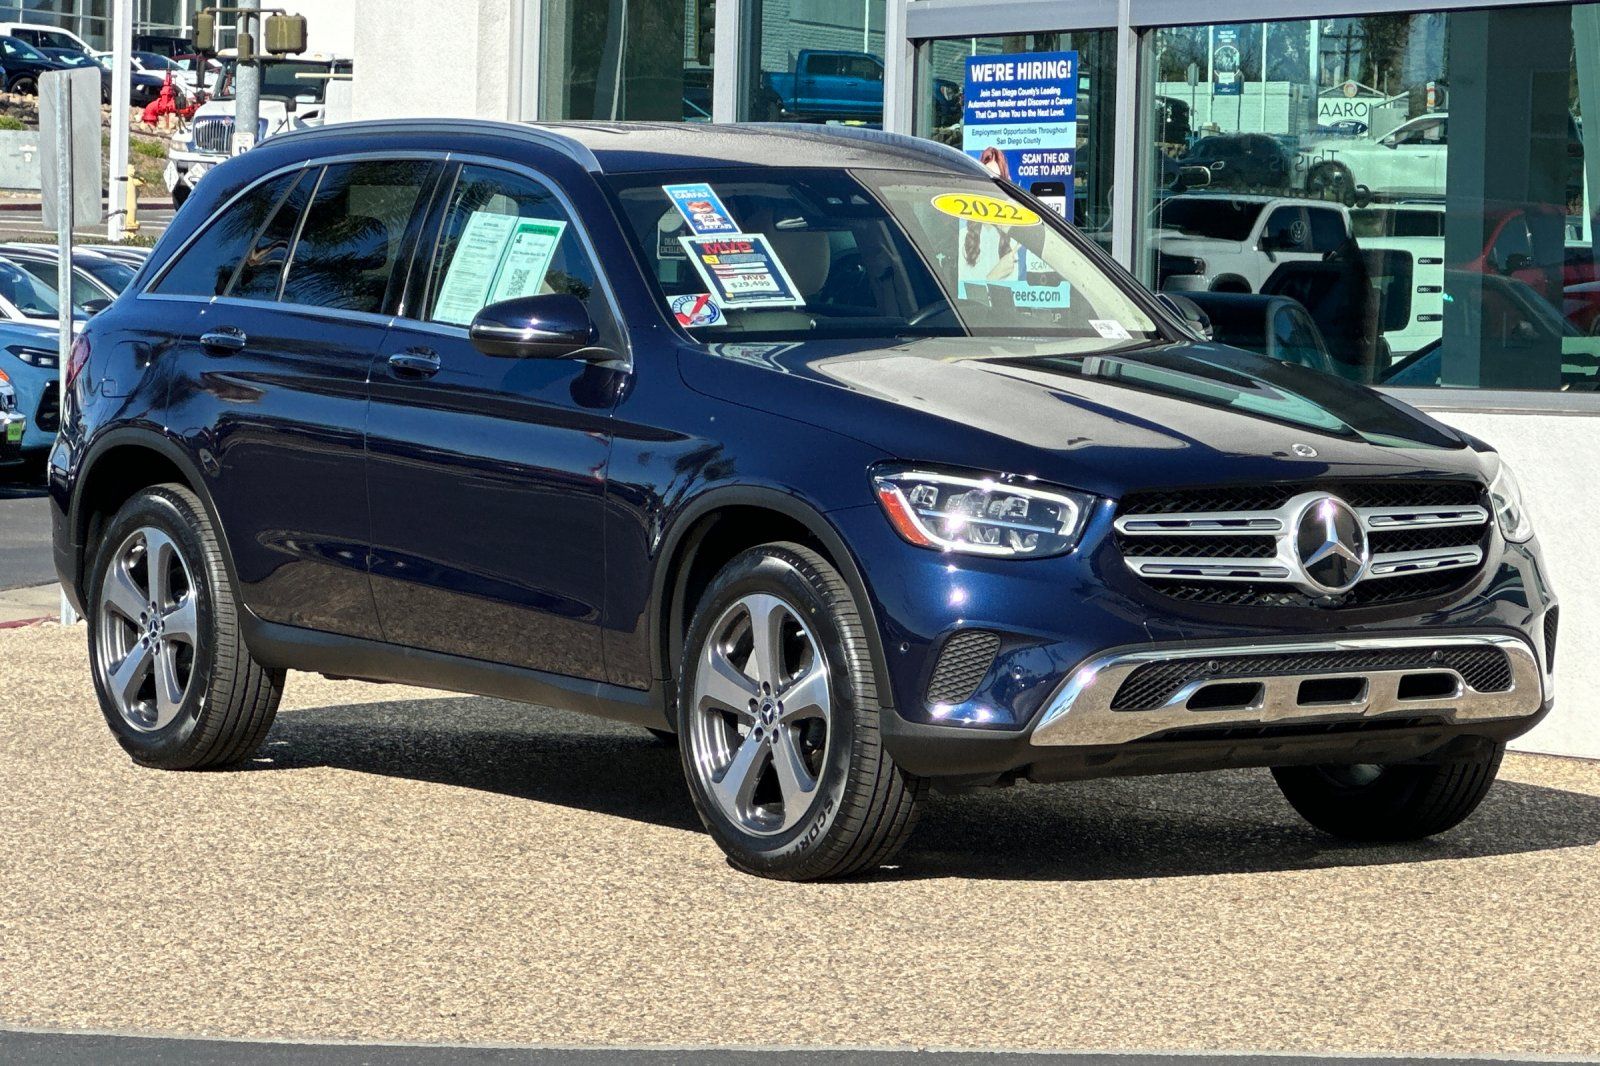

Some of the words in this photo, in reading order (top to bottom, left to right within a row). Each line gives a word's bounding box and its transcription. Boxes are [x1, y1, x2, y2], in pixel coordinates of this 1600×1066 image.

[971, 63, 1014, 82] WE'RE
[1017, 60, 1072, 80] HIRING!
[980, 89, 990, 98] Join
[991, 88, 1001, 96] San
[1002, 88, 1018, 98] Diego
[1018, 87, 1040, 97] County's
[1040, 86, 1061, 96] Leading
[968, 100, 996, 109] Automotive
[997, 100, 1016, 108] Retailer
[1017, 98, 1027, 106] and
[1028, 98, 1050, 106] Discover
[1055, 96, 1073, 106] Career
[975, 110, 986, 118] That
[987, 110, 998, 118] Can
[998, 110, 1010, 118] Take
[1011, 109, 1020, 118] You
[1028, 109, 1036, 117] the
[1037, 108, 1050, 117] Next
[1050, 108, 1064, 116] Level.
[1319, 102, 1371, 117] AARO
[972, 128, 1002, 137] Employment
[1003, 127, 1038, 136] Opportunities
[1038, 126, 1068, 136] Throughout
[1007, 136, 1022, 145] Diego
[1023, 136, 1041, 145] County
[1022, 153, 1042, 164] SCAN
[1042, 153, 1058, 163] THE
[1058, 153, 1070, 163] QR
[1018, 166, 1038, 176] CODE
[1040, 166, 1050, 175] TO
[1050, 165, 1072, 175] APPLY
[954, 198, 1022, 220] 2022
[702, 241, 752, 254] MVP
